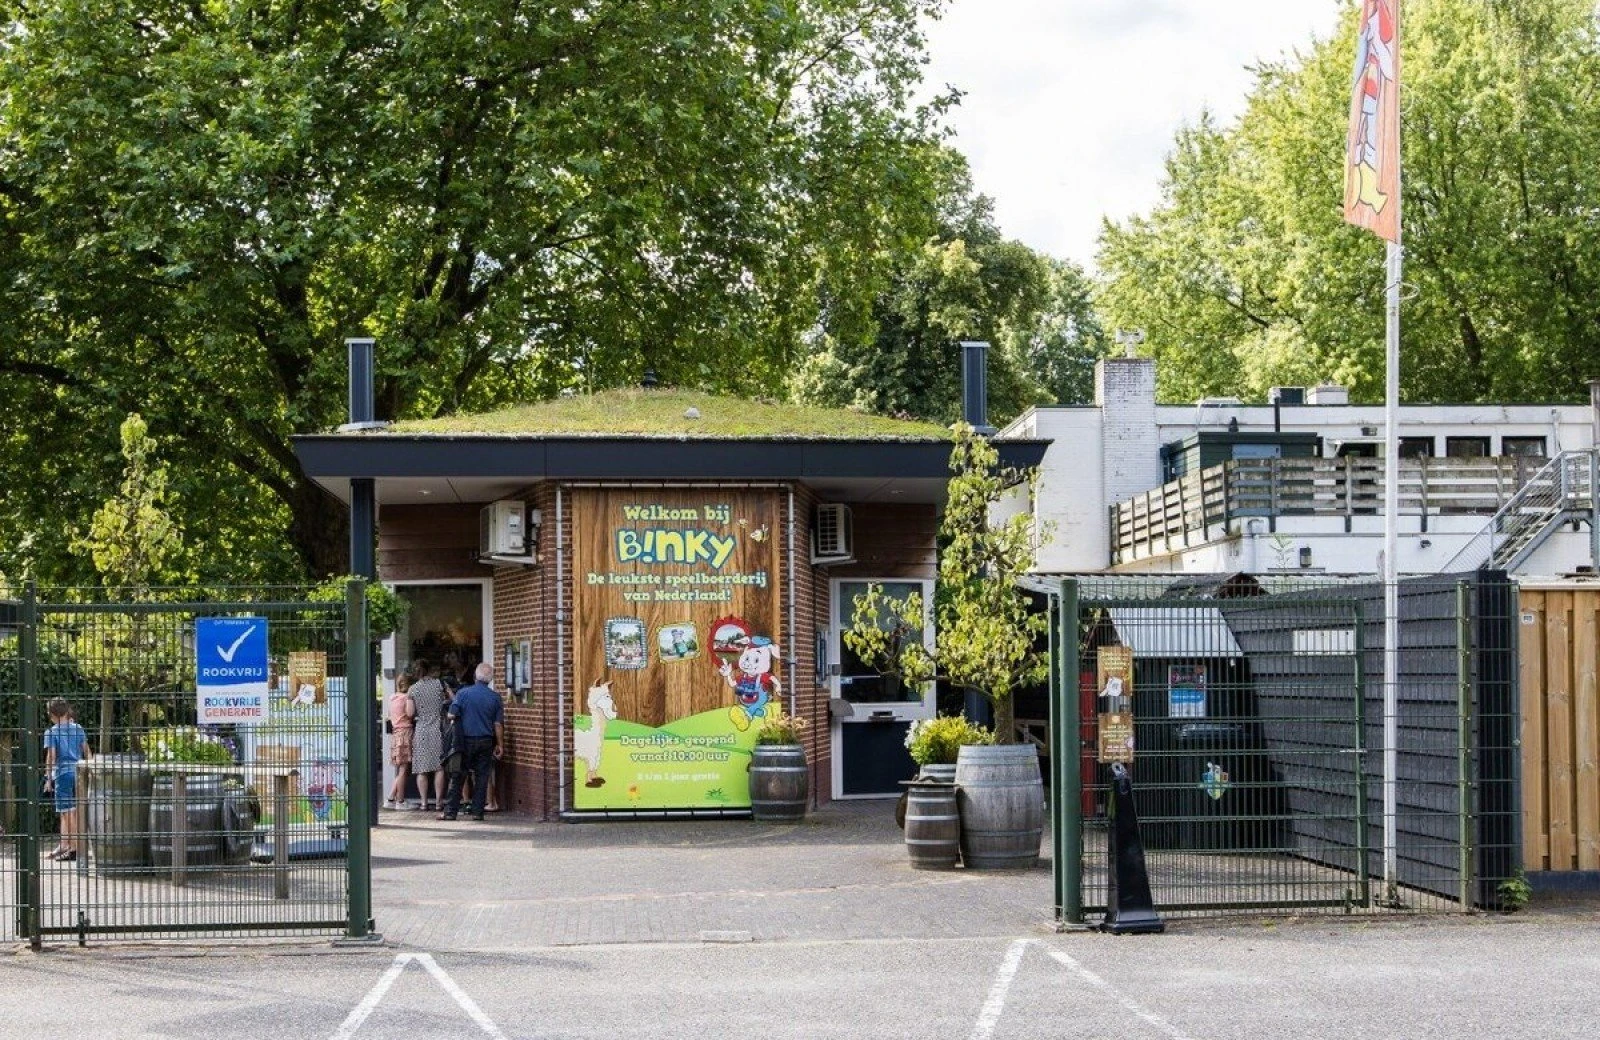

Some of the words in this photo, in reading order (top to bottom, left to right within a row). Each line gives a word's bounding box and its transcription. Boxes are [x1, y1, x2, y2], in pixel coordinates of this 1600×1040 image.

[624, 505, 698, 521] Welkom
[704, 505, 731, 525] bij
[587, 573, 604, 585] De
[608, 573, 661, 585] leukste
[665, 572, 767, 588] speelboerderij
[623, 591, 650, 601] van
[654, 589, 732, 601] Nederland!
[203, 667, 262, 677] ROOKVRIJ
[204, 697, 261, 707] ROOKVRIJE
[204, 708, 261, 717] GENERATIE
[621, 735, 680, 748] Dagelijks
[684, 734, 735, 747] geopend
[631, 751, 669, 761] vanaf
[671, 751, 704, 761] 10:00
[707, 752, 729, 761] uur
